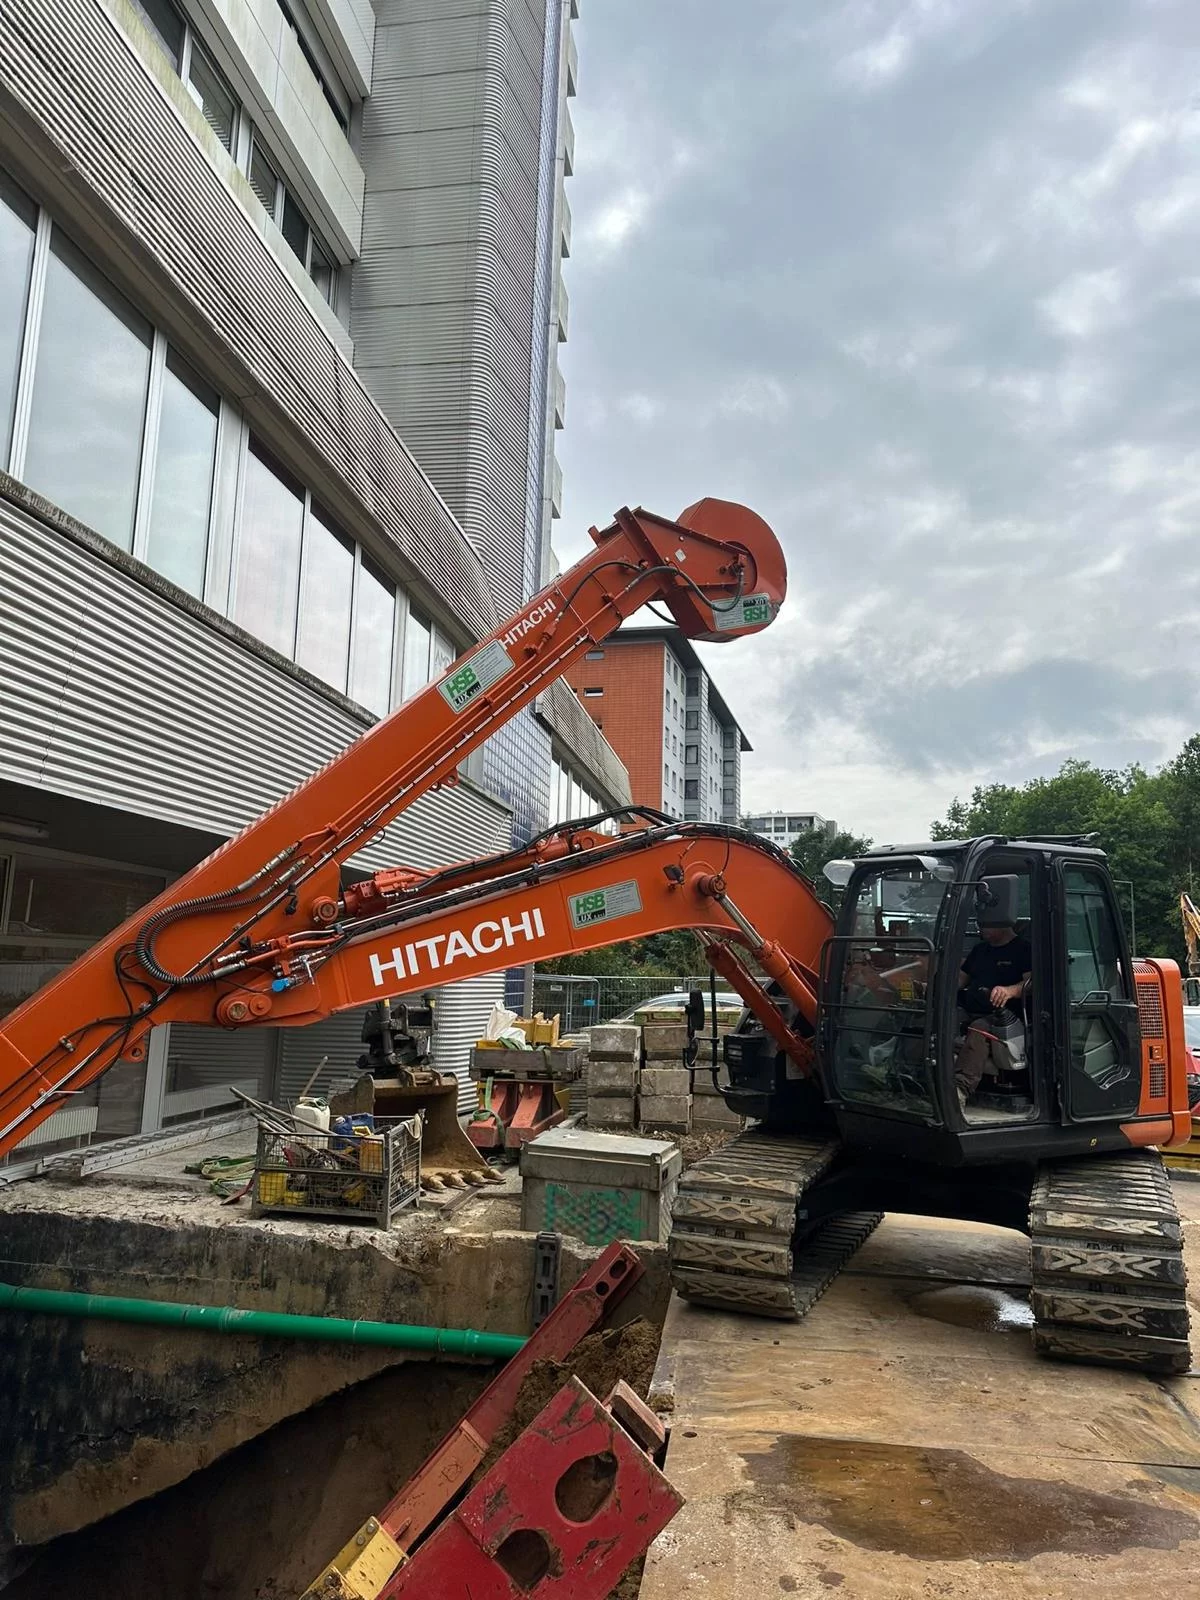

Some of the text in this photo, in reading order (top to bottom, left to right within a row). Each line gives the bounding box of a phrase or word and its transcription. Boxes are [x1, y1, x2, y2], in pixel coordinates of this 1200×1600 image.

[498, 598, 556, 650] HITACHI
[743, 605, 768, 623] HSB
[445, 667, 477, 699] HSB
[453, 691, 471, 706] LUX
[576, 893, 606, 914] HSB
[576, 911, 593, 925] LUX
[368, 907, 546, 987] HITACHI
